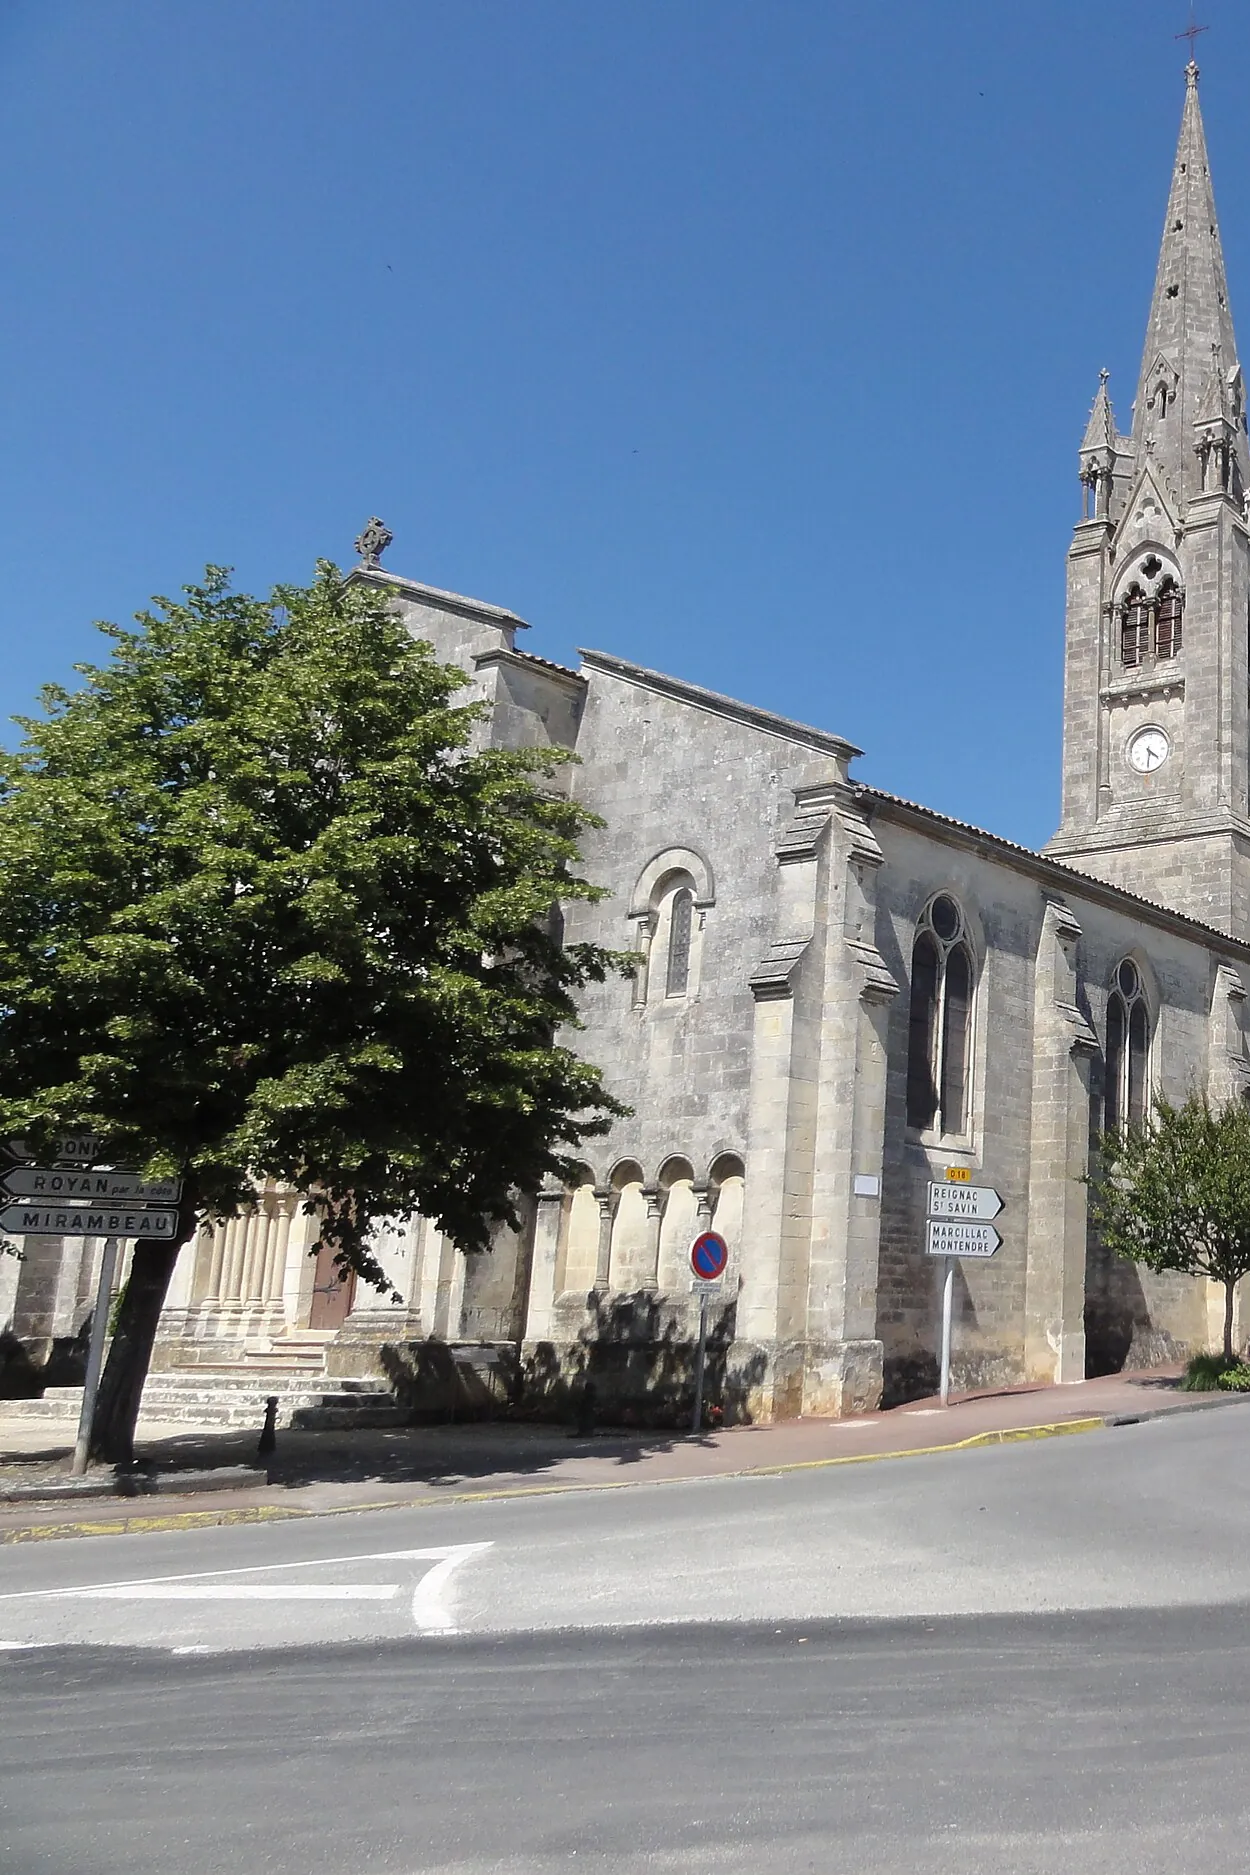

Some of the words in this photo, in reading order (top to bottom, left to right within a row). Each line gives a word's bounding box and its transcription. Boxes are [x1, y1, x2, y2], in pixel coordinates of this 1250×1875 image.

[950, 1170, 956, 1178] D
[34, 1175, 109, 1194] ROYAN
[111, 1185, 130, 1196] par
[934, 1188, 978, 1201] REIGNAC
[948, 1203, 978, 1214] SAVIN
[23, 1212, 168, 1232] MIRAMBEAU
[932, 1226, 988, 1239] MARCILLAC
[932, 1239, 989, 1253] MONTENDRE
